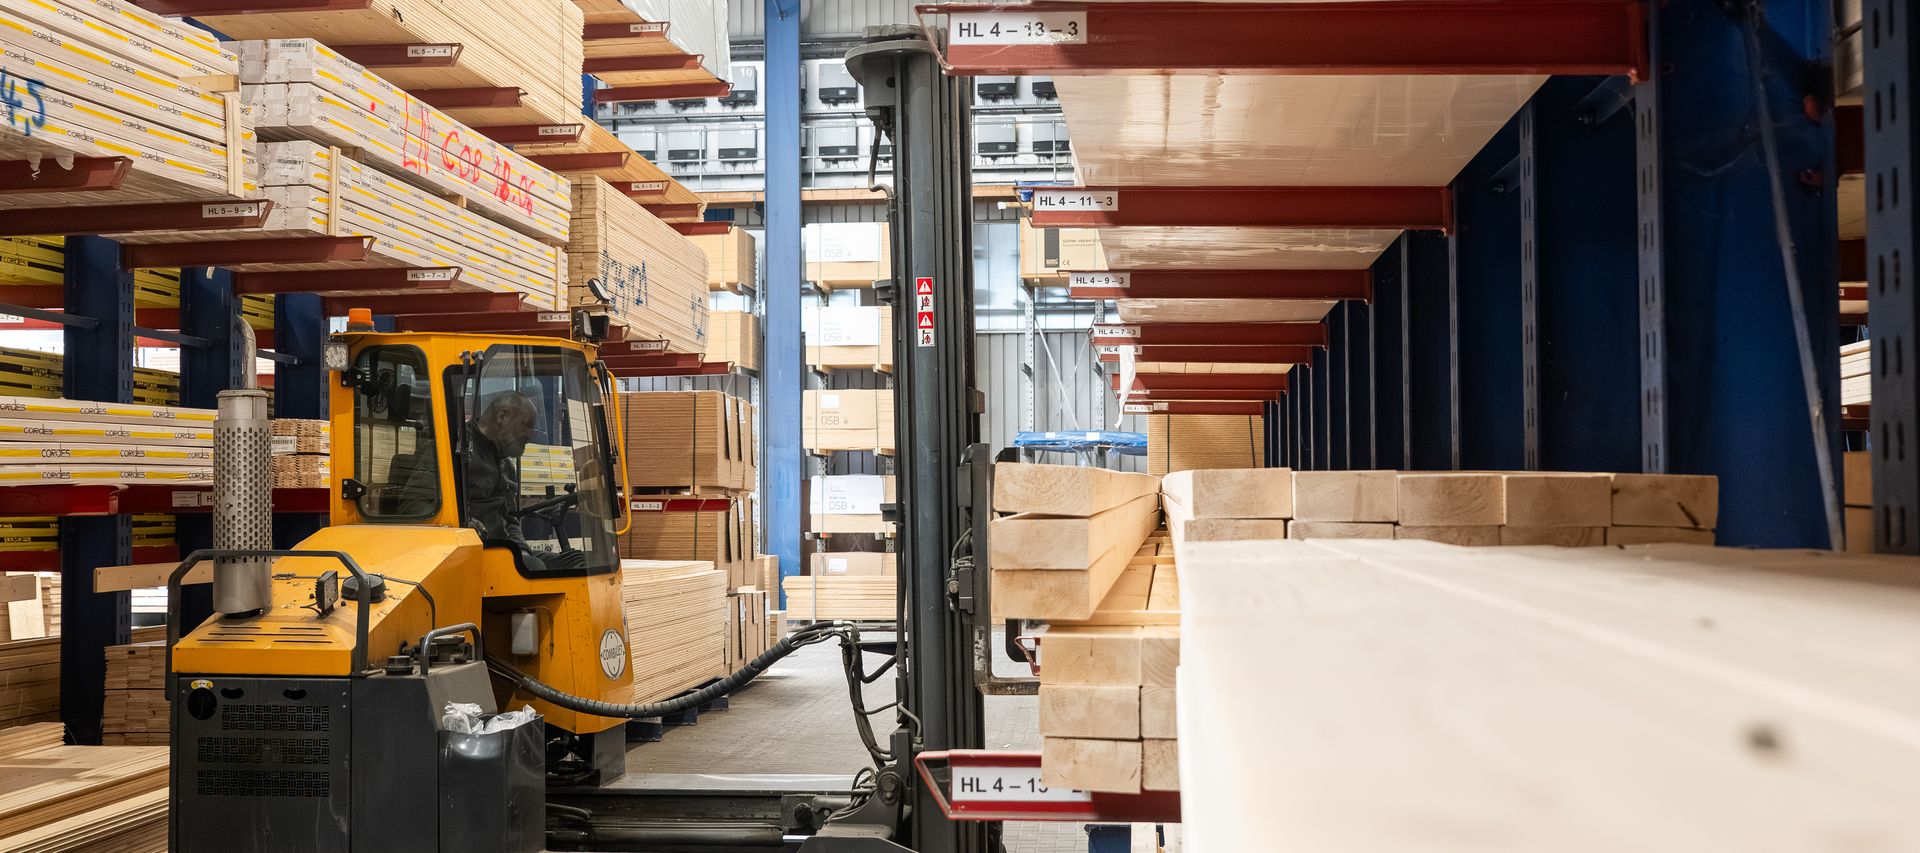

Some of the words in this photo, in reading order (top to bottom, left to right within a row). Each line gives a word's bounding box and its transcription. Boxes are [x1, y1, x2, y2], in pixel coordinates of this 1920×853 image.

[959, 22, 984, 37] HL
[990, 22, 1001, 37] 4
[1024, 21, 1045, 37] 13
[1067, 21, 1078, 36] 3
[1040, 196, 1055, 206] HL
[1059, 196, 1065, 206] 4
[1080, 196, 1091, 206] 11
[1106, 196, 1113, 206] 3
[822, 416, 840, 426] OSB
[829, 501, 848, 510] OSB
[961, 777, 987, 793] HL
[992, 777, 1004, 793] 4
